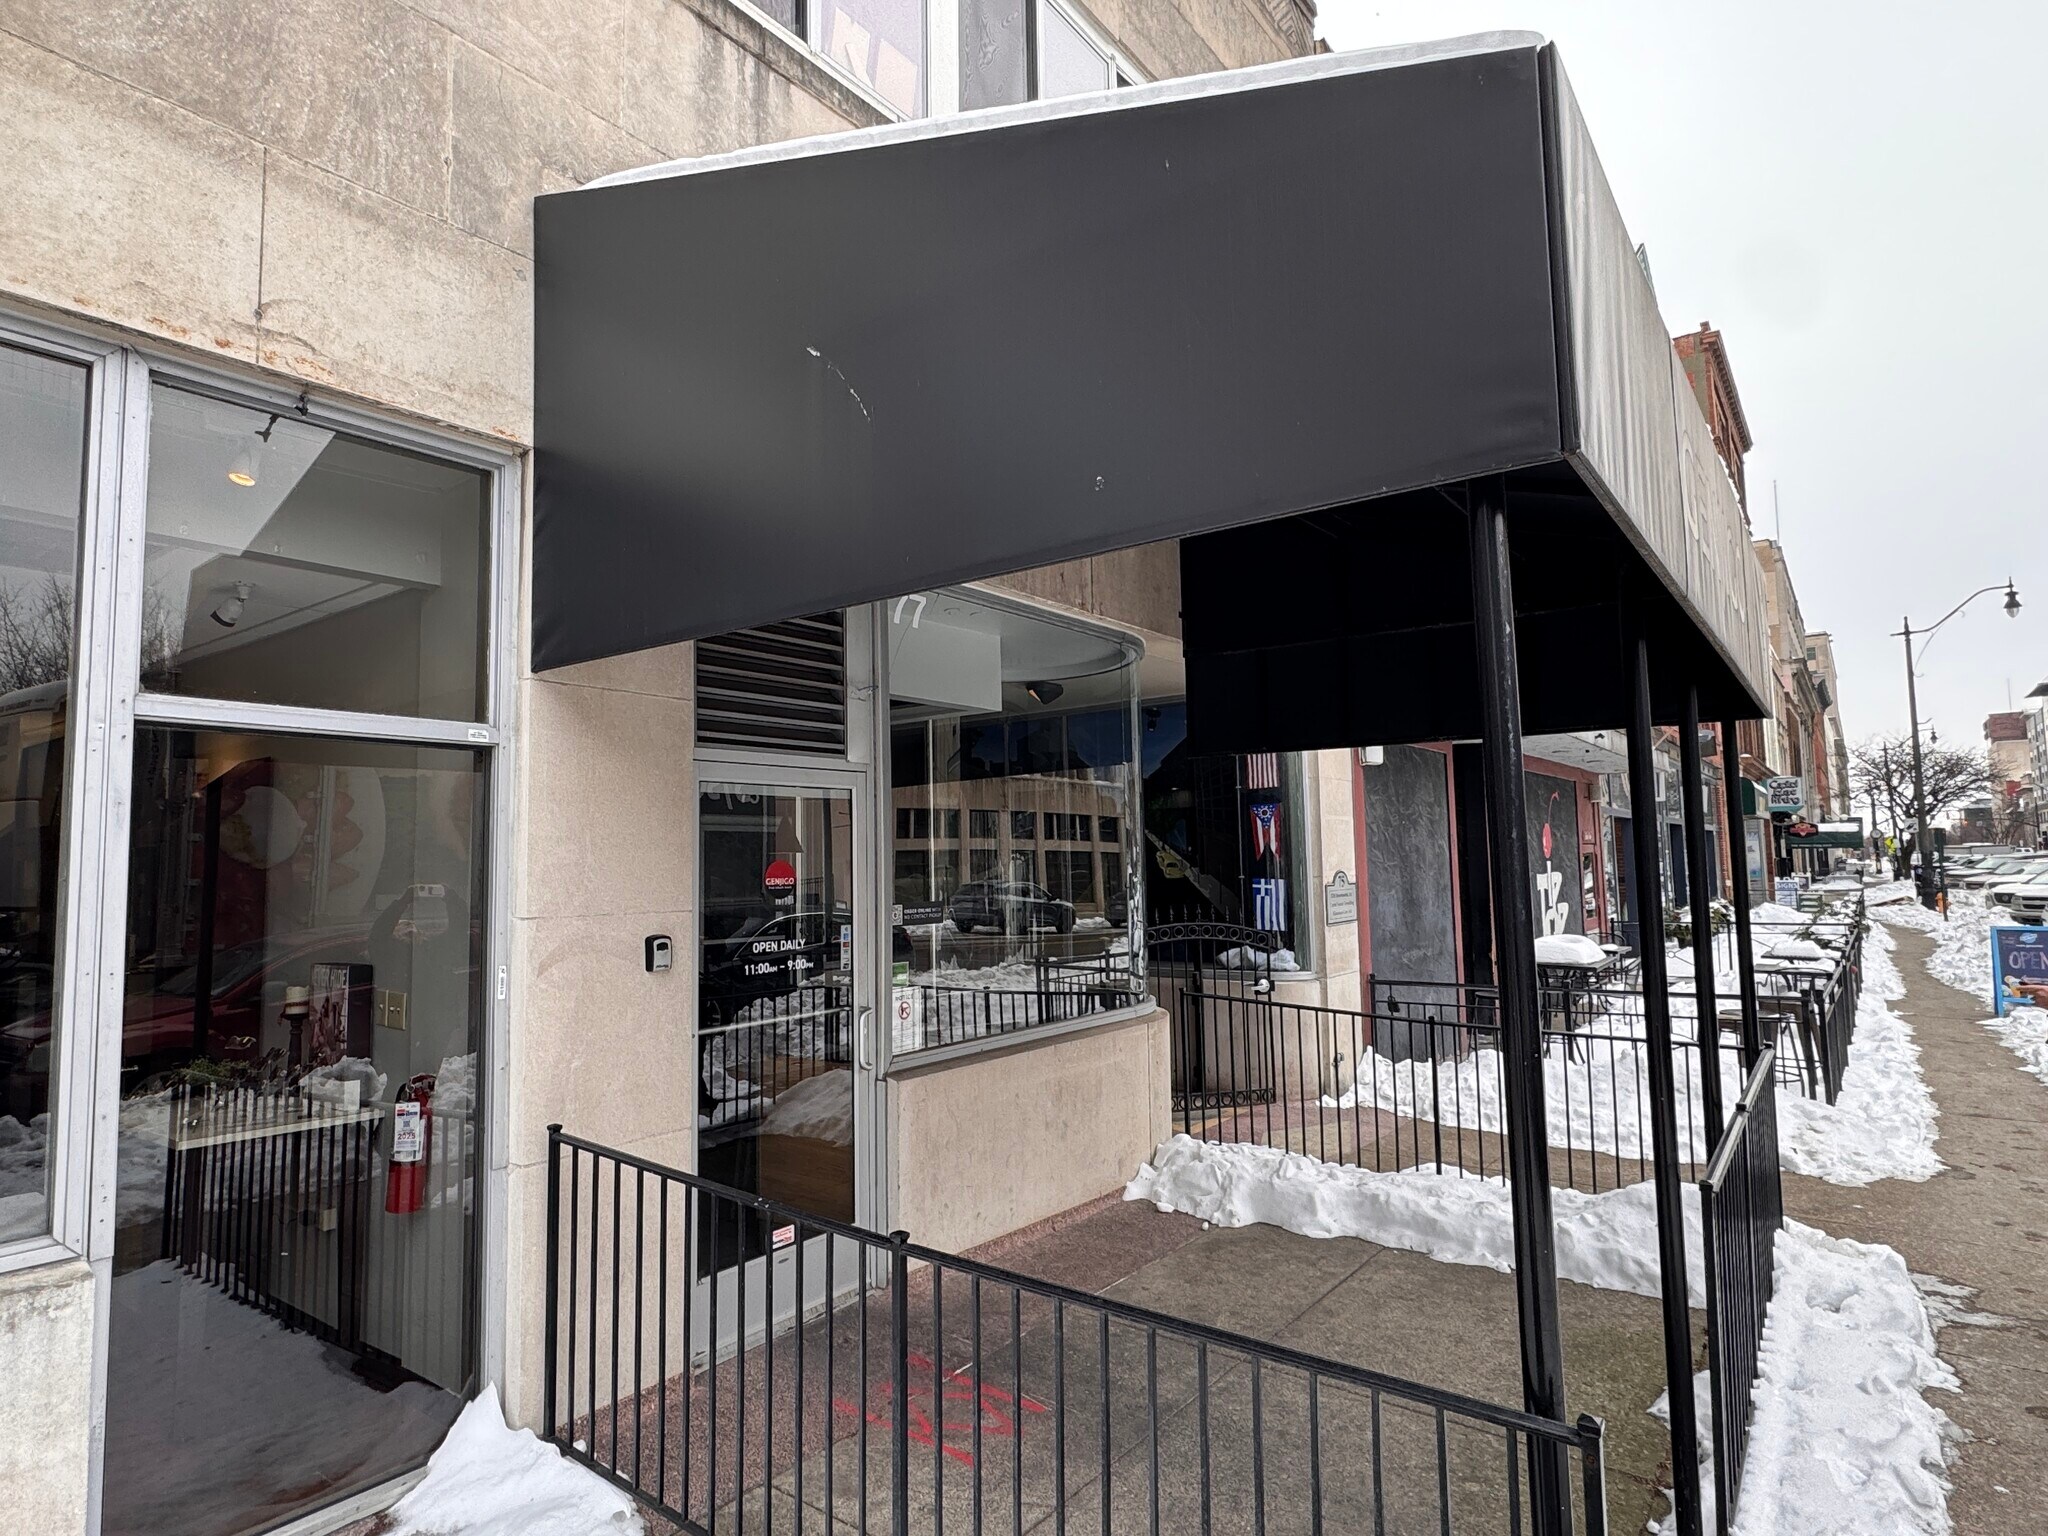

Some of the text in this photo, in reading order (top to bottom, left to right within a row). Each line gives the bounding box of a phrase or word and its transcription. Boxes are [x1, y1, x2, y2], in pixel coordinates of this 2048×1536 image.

[765, 877, 795, 886] GENJIGO
[1776, 882, 1798, 890] SIGNS
[752, 938, 806, 954] OPEN DAILY
